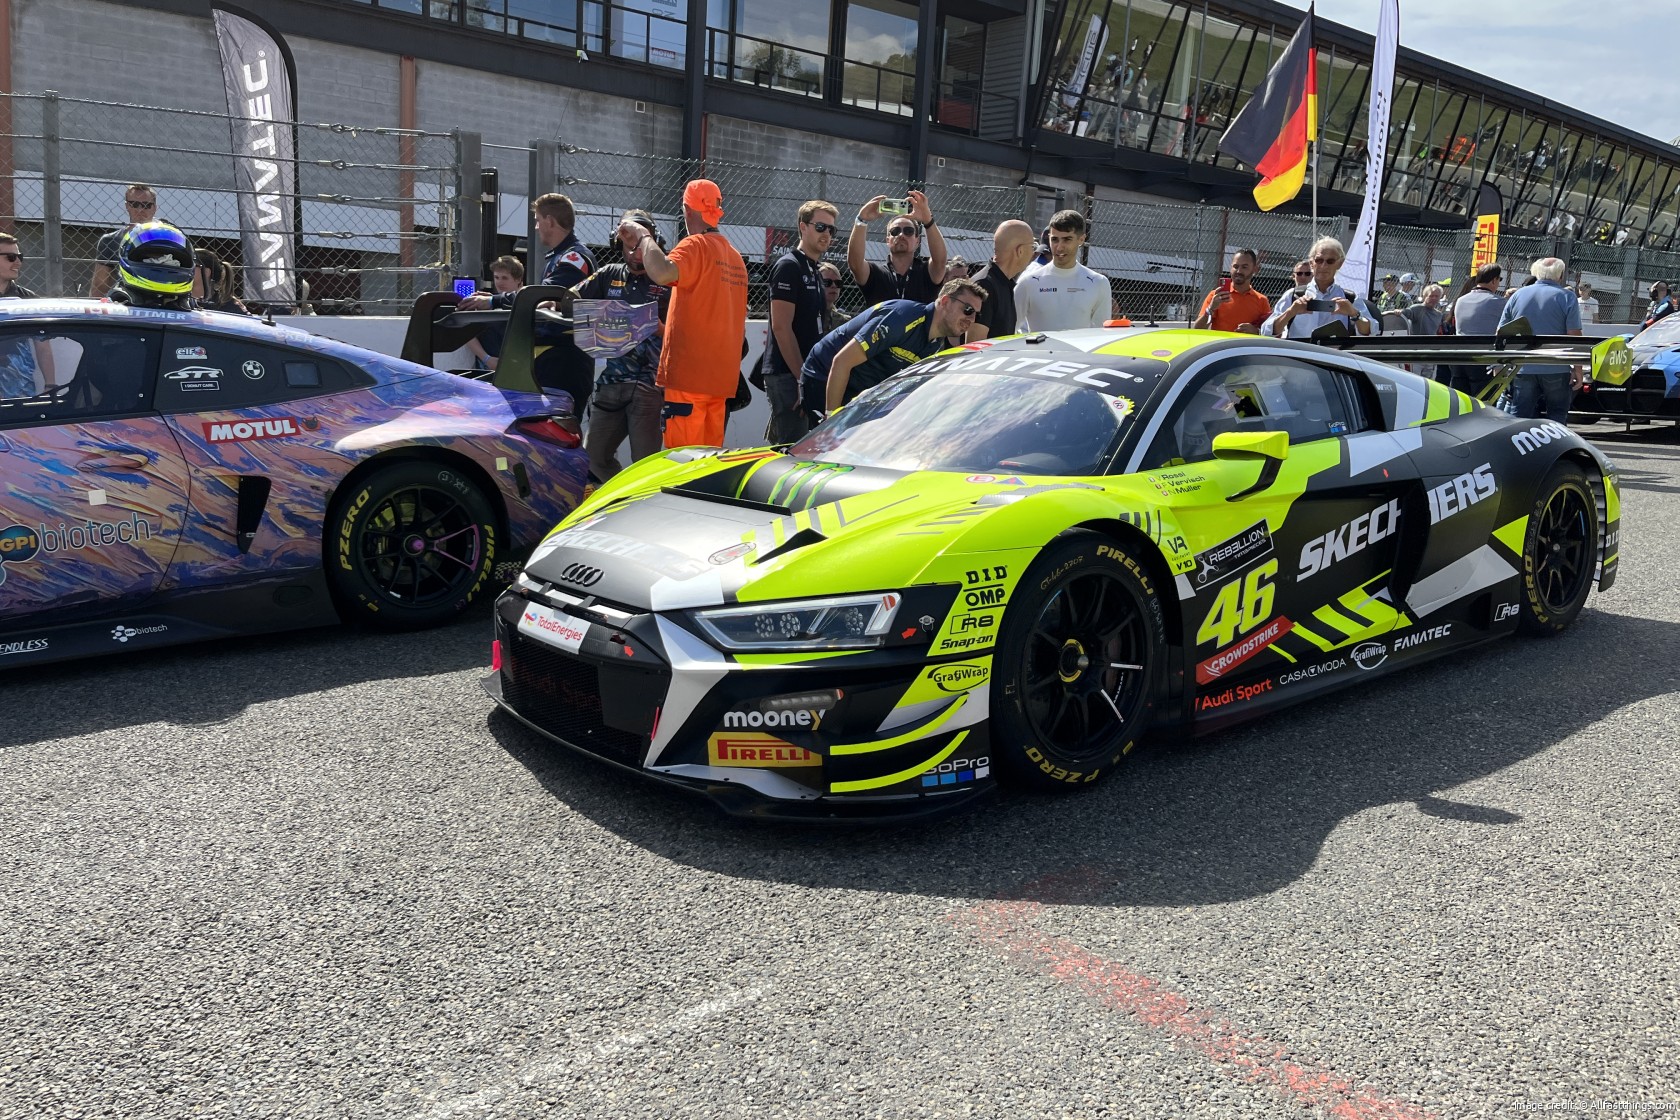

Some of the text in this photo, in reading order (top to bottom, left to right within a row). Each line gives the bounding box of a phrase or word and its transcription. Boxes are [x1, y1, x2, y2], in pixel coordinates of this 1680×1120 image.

[1609, 350, 1628, 365] aws
[210, 419, 296, 441] MOTUL
[1161, 472, 1186, 480] Rossi
[1168, 475, 1205, 487] Vervisch
[1175, 484, 1202, 494] Muller
[40, 512, 150, 553] biotech
[0, 535, 36, 552] GPI
[1209, 526, 1265, 565] REBELLION
[467, 524, 495, 602] PIRELLI
[1096, 544, 1155, 595] PIRELLI
[965, 587, 1006, 607] OMP
[1196, 557, 1279, 649] 46
[136, 624, 168, 635] biotech
[537, 615, 583, 641] TotalEnergies
[961, 615, 994, 630] R8
[0, 638, 49, 654] ENDLESS
[940, 635, 994, 649] Snap-on
[1211, 622, 1279, 671] CROWDSTRIKE
[1394, 624, 1451, 651] FANATEC
[1354, 644, 1387, 662] GrafiWrap
[933, 667, 989, 683] GrafiWrap
[1202, 678, 1273, 711] Audi Sport
[724, 709, 826, 731] mooney
[717, 739, 811, 761] PIRELLI
